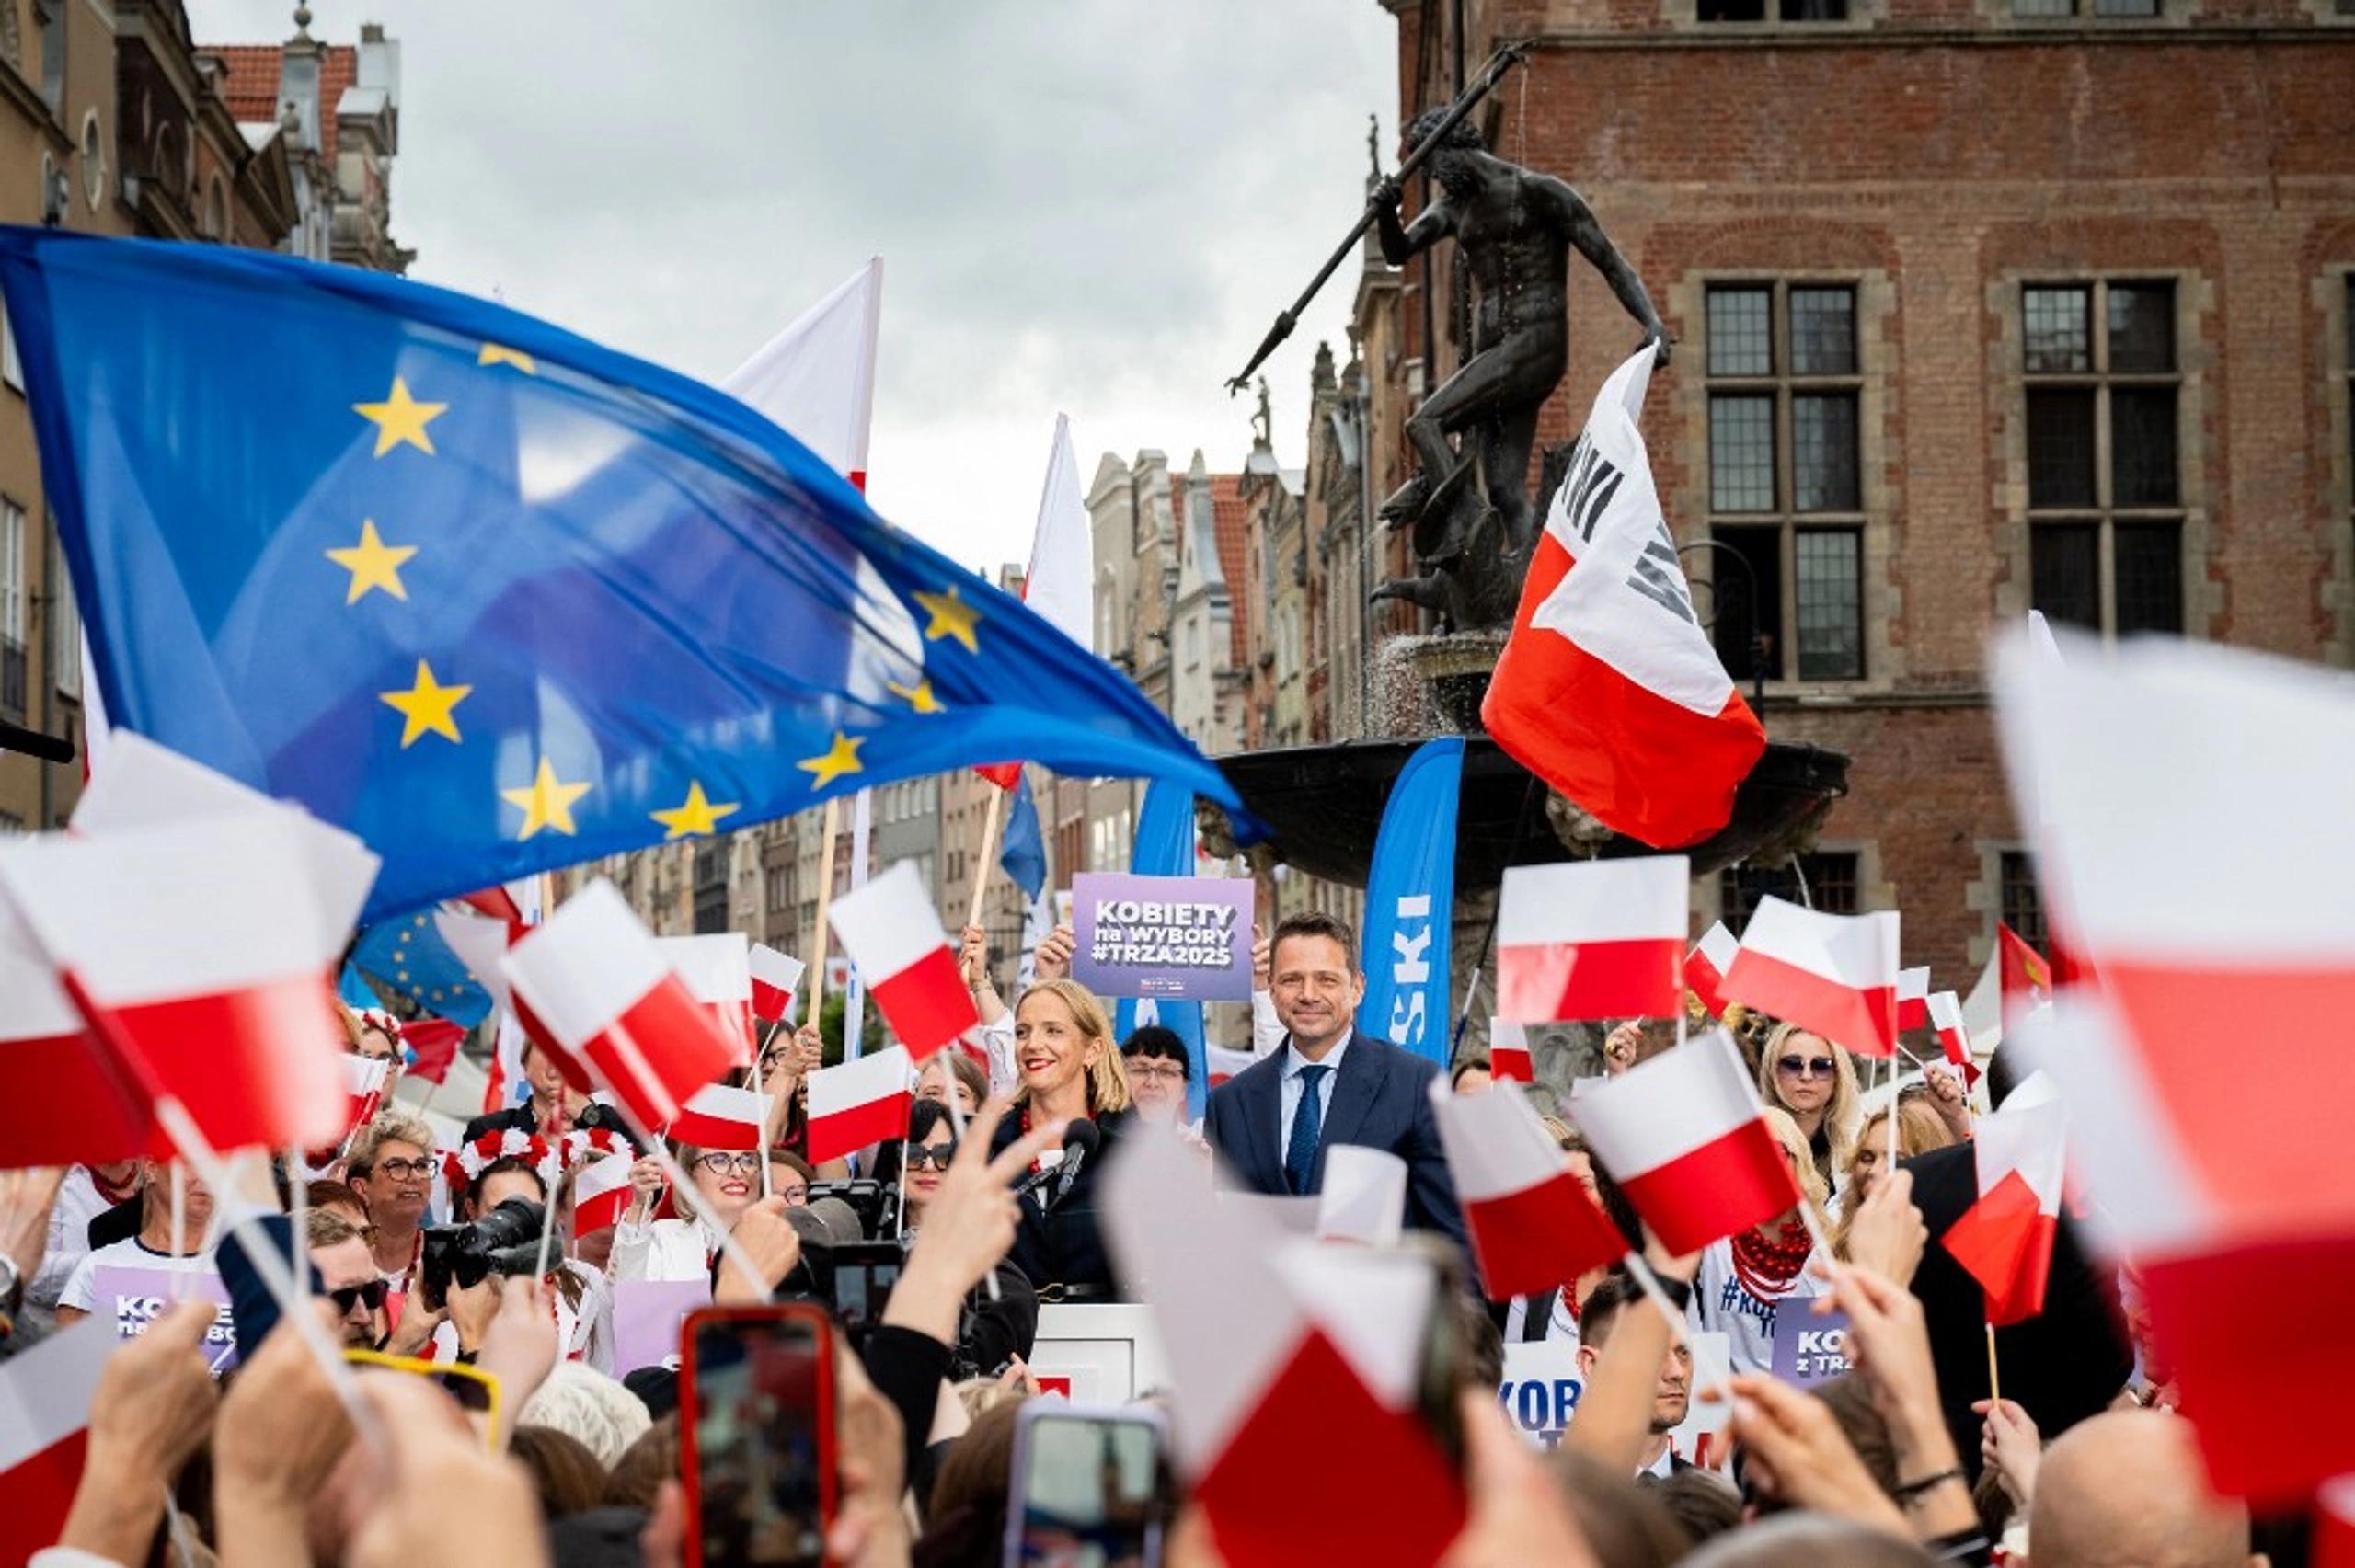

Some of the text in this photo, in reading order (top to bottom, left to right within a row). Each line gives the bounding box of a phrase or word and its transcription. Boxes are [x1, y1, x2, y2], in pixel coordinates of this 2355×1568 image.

[1096, 900, 1235, 927] KOBIETY
[1095, 926, 1234, 945] na WYBORY
[1091, 943, 1233, 967] #TRZA2025
